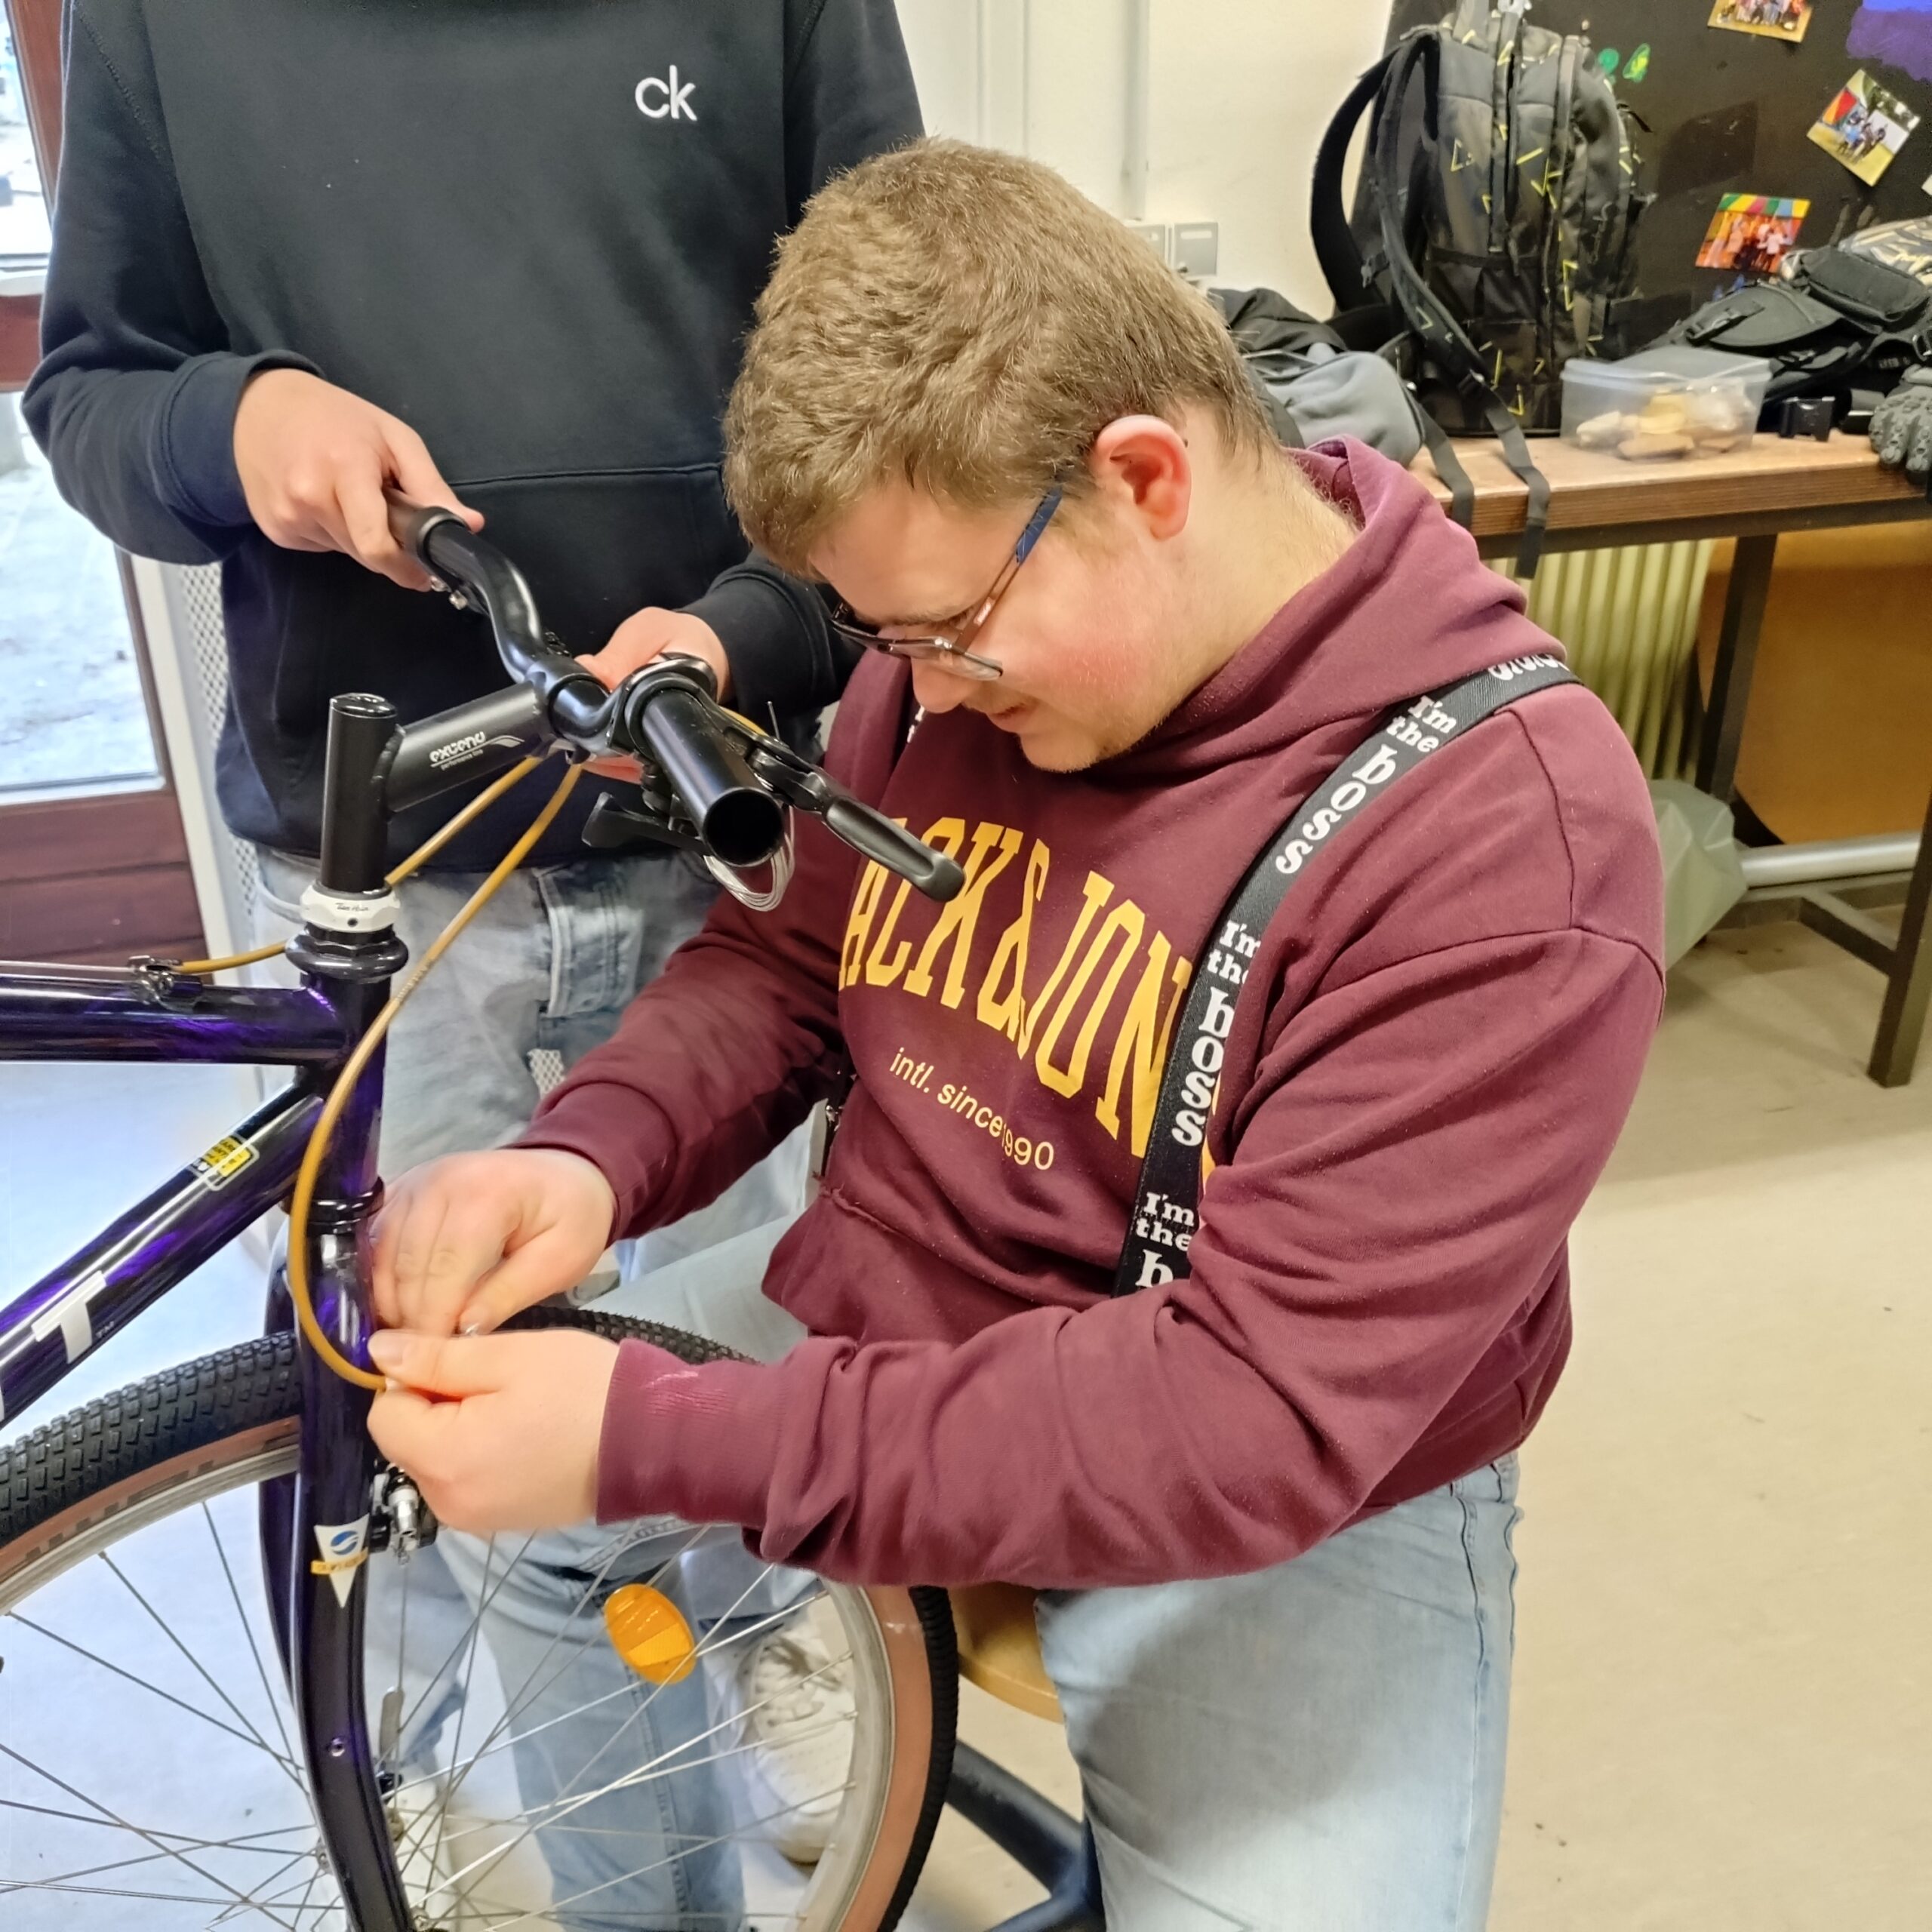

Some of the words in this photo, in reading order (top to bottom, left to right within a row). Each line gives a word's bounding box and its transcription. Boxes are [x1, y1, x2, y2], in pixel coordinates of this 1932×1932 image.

[635, 64, 697, 121] ck
[1386, 715, 1440, 753] the
[1408, 695, 1457, 734] I'm
[1275, 744, 1398, 874] boss
[1208, 949, 1249, 985] th
[1017, 870, 1221, 1195] JON
[1172, 986, 1235, 1146] boss
[890, 1047, 934, 1093] intl.
[937, 1084, 1003, 1137] since
[1143, 1192, 1195, 1227] I'm
[1136, 1217, 1193, 1252] the
